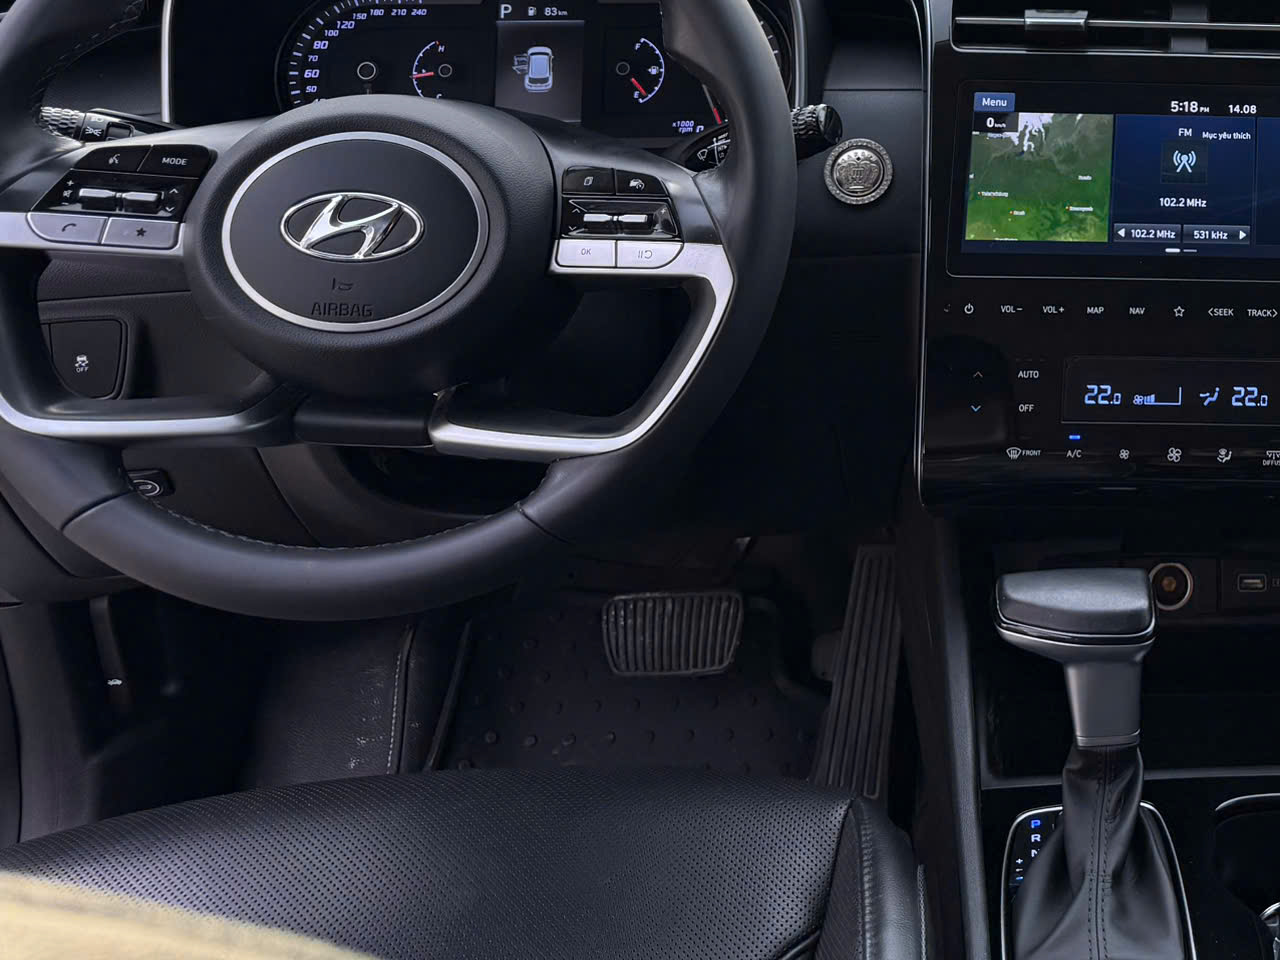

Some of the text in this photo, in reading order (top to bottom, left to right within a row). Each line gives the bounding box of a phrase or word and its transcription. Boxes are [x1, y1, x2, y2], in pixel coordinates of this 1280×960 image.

[500, 3, 512, 19] P
[544, 7, 558, 16] 83
[336, 20, 355, 29] 120
[313, 41, 328, 49] 80
[304, 69, 320, 78] 60
[982, 98, 1007, 107] Menu
[1170, 101, 1198, 112] 5:18
[1228, 105, 1257, 114] 14.08
[986, 117, 994, 128] 0
[1178, 128, 1192, 137] FM
[162, 157, 188, 166] MODE
[1160, 198, 1207, 207] 102.2 MHz
[1131, 229, 1176, 239] 102.2 MHz
[1193, 230, 1228, 240] 531 kHz
[581, 248, 591, 256] OK
[310, 302, 373, 317] AIRBAG
[1086, 306, 1104, 314] MAP
[1129, 307, 1145, 315] NAV
[1018, 370, 1039, 379] AUTO
[1084, 385, 1121, 405] 22.0
[1231, 387, 1268, 407] 22.0
[1018, 404, 1034, 412] OFF
[1066, 450, 1082, 458] A/C
[1031, 820, 1041, 828] P
[1031, 833, 1041, 842] R
